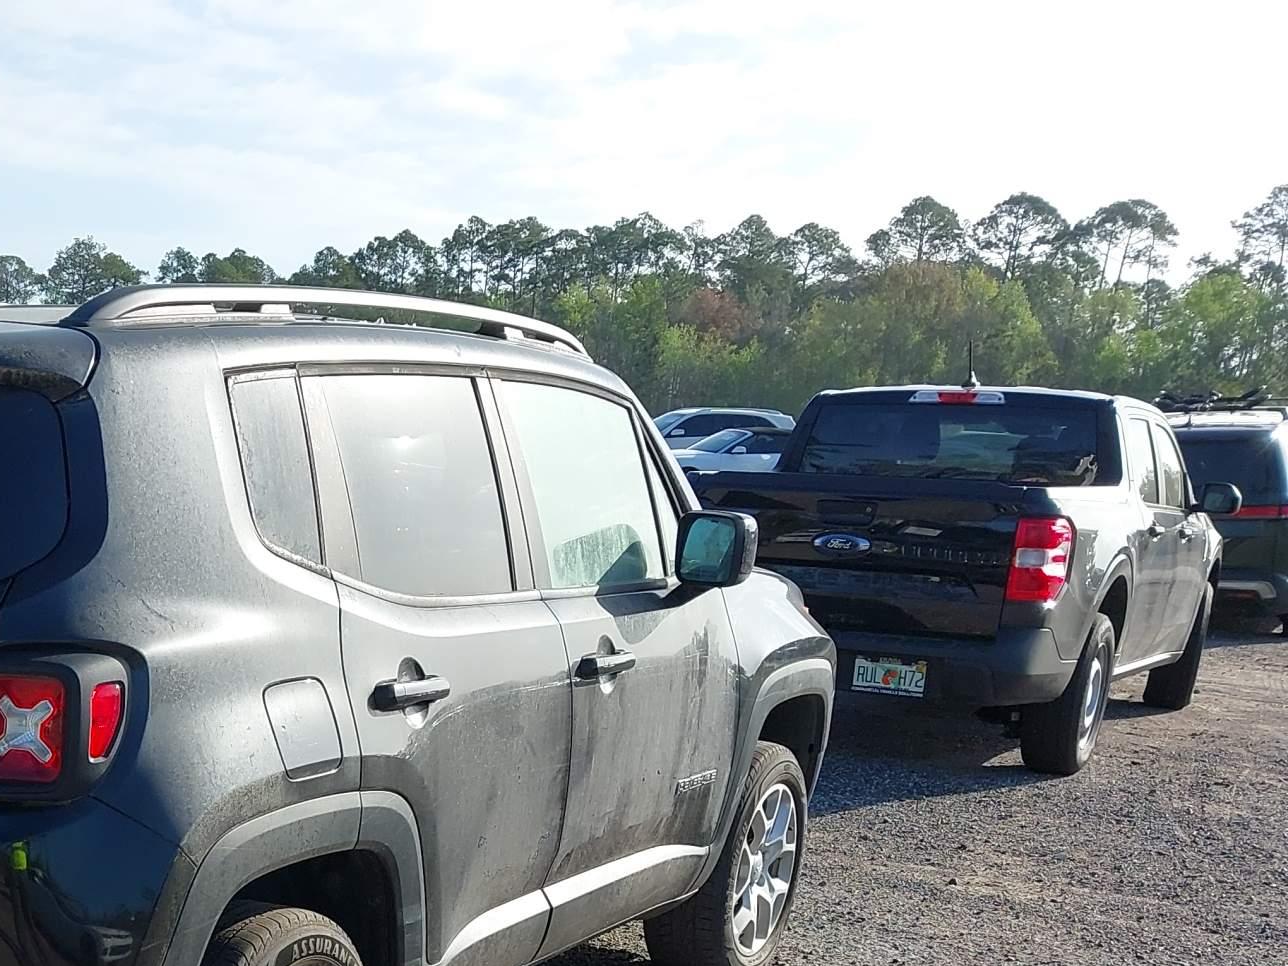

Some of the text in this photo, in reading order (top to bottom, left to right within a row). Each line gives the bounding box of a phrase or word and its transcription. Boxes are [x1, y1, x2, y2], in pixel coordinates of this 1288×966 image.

[827, 538, 852, 549] Ford
[856, 665, 925, 688] RUL H72
